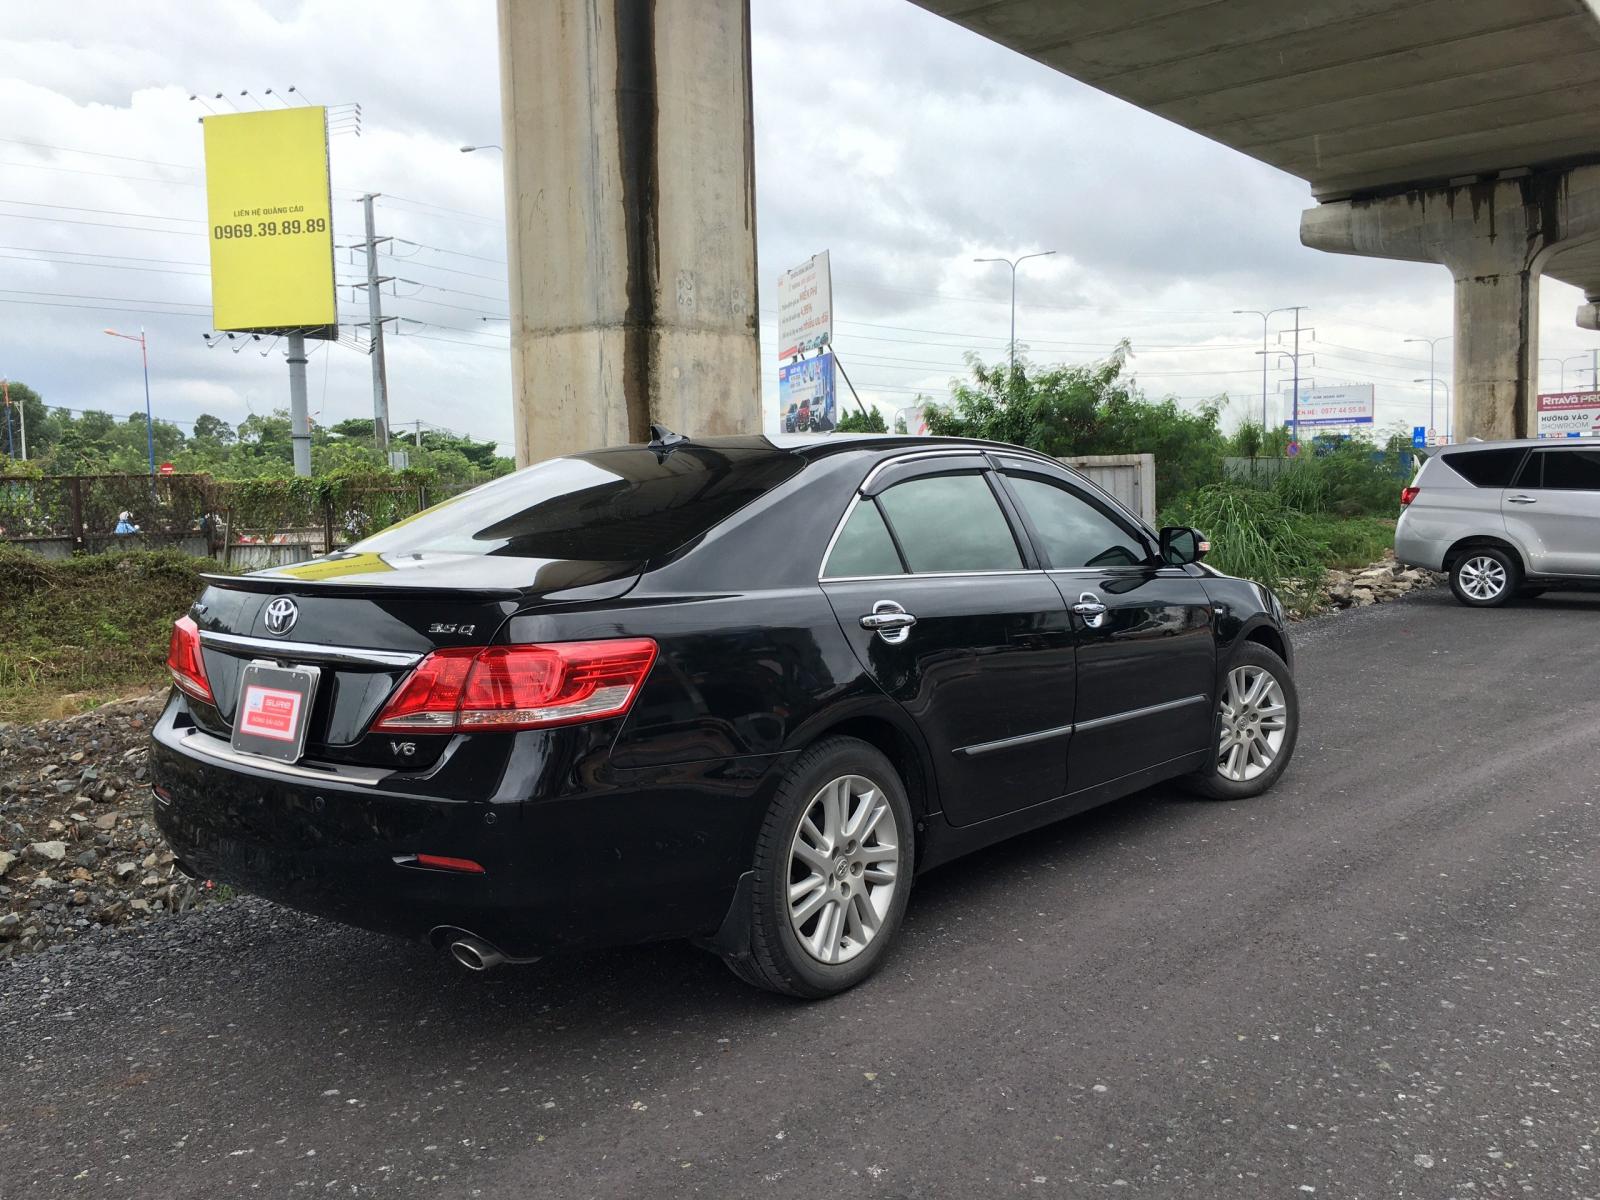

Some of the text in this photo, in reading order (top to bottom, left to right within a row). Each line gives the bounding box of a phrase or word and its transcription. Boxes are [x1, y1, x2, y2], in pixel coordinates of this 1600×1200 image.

[233, 207, 250, 217] LIÊN
[214, 218, 326, 240] 0969.39.89.89
[1541, 421, 1589, 430] SHOWROOM
[390, 741, 417, 756] V6
